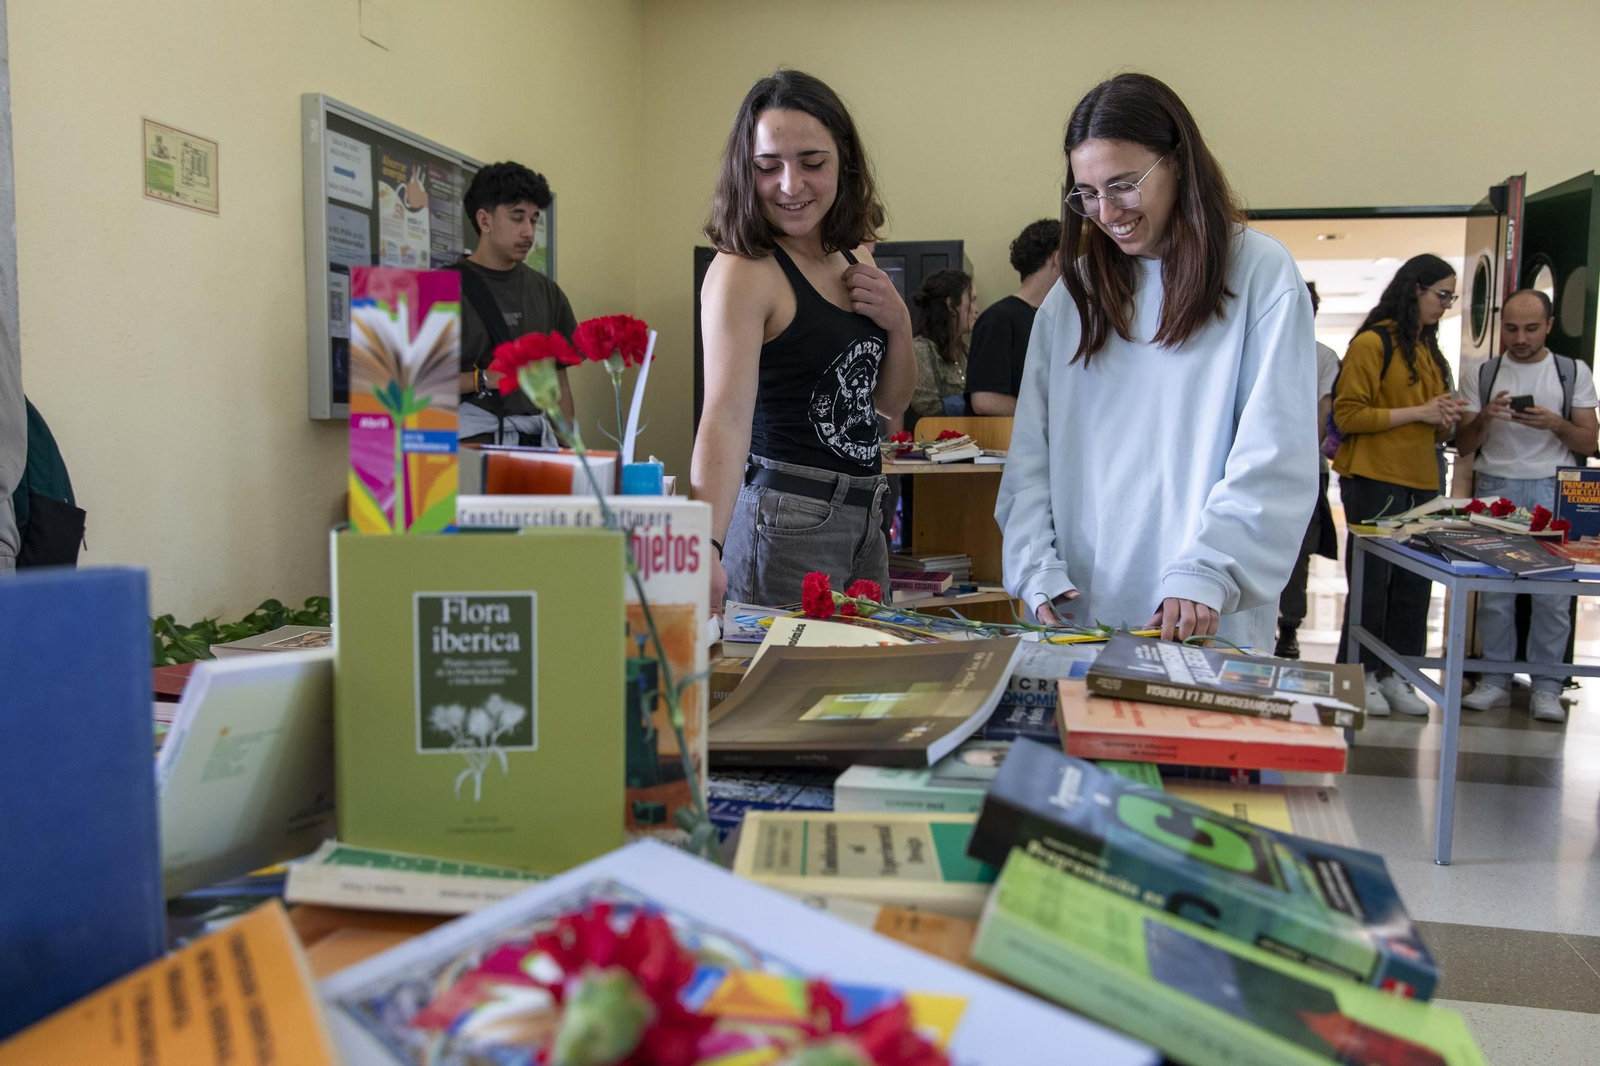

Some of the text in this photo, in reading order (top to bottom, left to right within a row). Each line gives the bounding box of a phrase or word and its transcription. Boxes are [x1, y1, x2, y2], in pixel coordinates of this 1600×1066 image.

[457, 507, 568, 528] Construcción
[573, 508, 593, 528] de
[630, 525, 700, 582] bjetos
[442, 597, 512, 624] Flora
[432, 625, 521, 654] iberica
[1185, 689, 1200, 702] LA
[1199, 691, 1214, 704] DE
